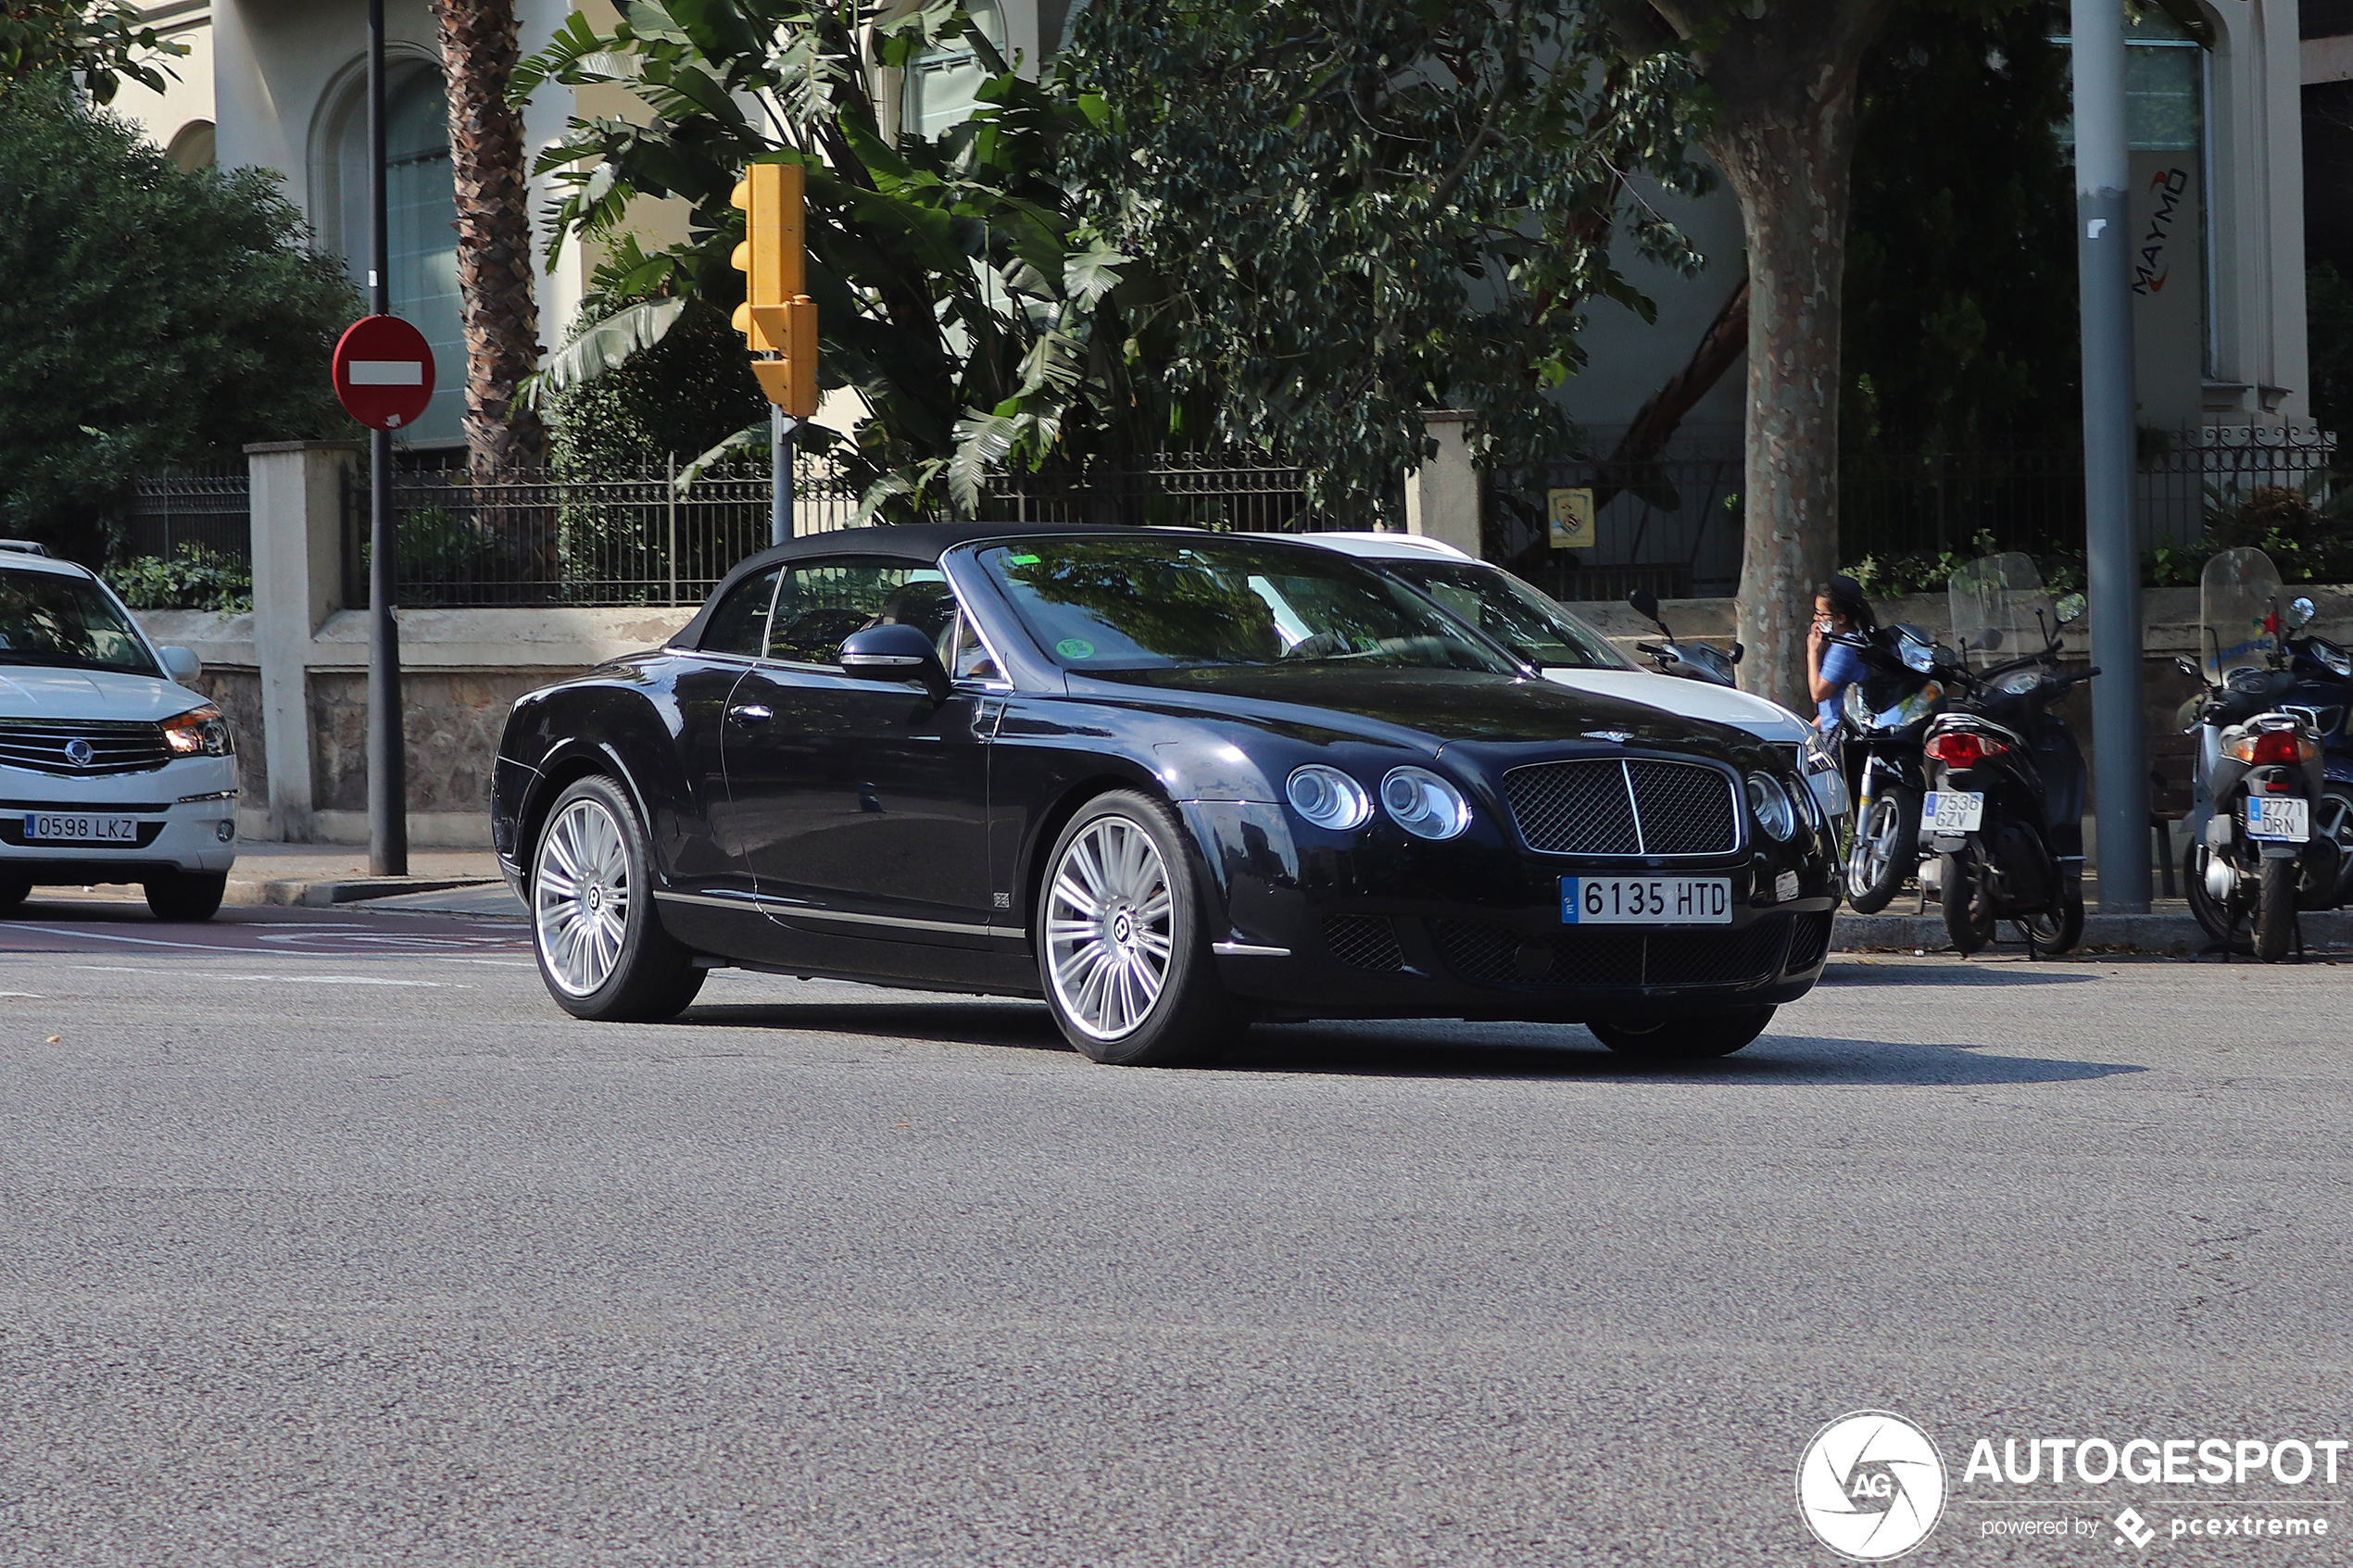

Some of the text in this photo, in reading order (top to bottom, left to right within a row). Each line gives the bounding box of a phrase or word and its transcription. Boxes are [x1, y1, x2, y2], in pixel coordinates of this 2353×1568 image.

[2132, 168, 2188, 295] MAYMO
[1936, 795, 1980, 811] 7536
[2262, 800, 2303, 817] 2771
[39, 817, 88, 836] 0598
[95, 819, 132, 838] LKZ
[1934, 811, 1968, 827] GZV
[2263, 817, 2296, 834] DRN
[1567, 882, 1725, 915] E 6135 HTD
